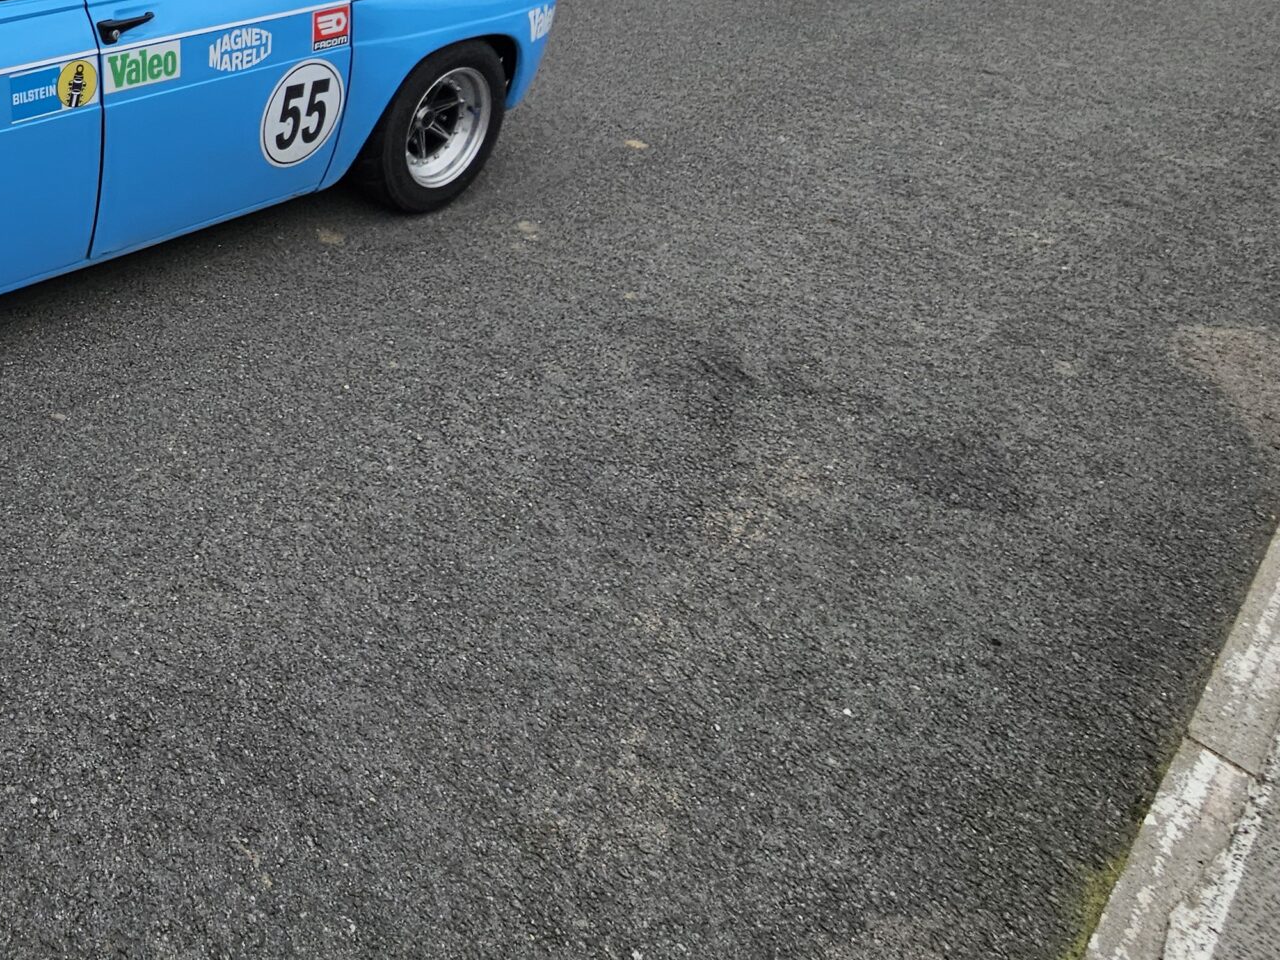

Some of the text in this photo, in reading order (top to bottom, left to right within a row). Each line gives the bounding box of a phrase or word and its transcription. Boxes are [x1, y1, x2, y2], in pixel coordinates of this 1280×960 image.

[107, 48, 177, 89] Valeo
[12, 84, 57, 106] BILSTEIN
[275, 78, 331, 151] 55
